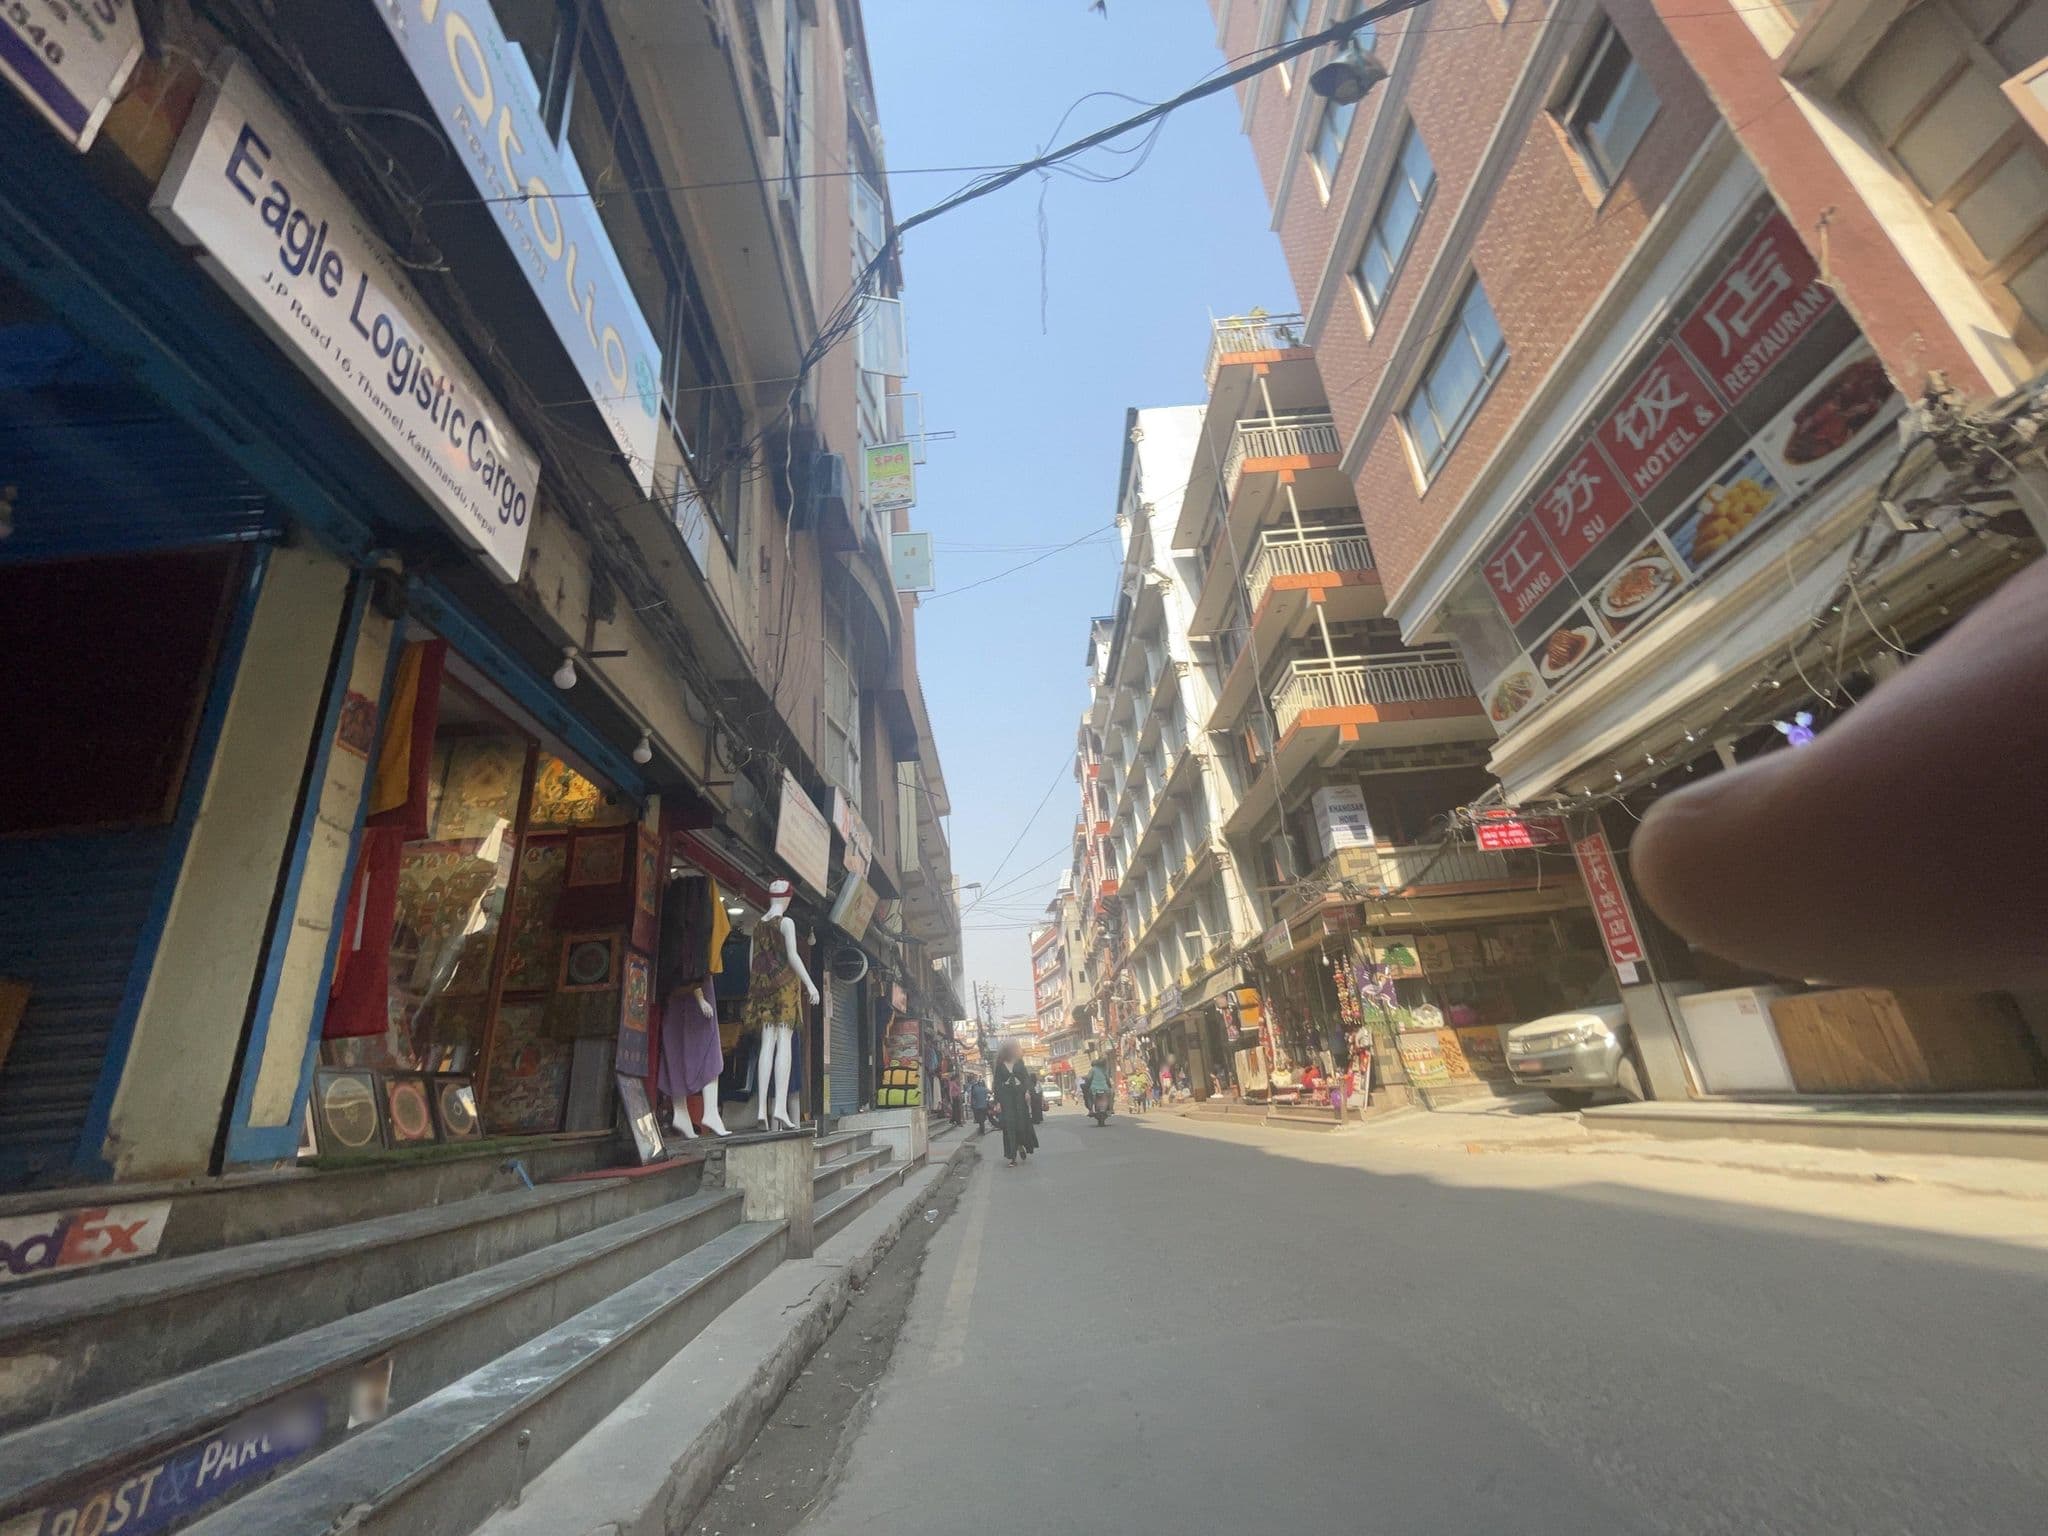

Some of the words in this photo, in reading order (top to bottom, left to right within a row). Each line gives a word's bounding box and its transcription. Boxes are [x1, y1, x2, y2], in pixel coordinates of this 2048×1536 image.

[225, 121, 343, 298] Eagle
[350, 271, 465, 449] Logistic
[468, 420, 526, 527] Cargo
[290, 298, 331, 350] Road
[357, 370, 405, 436] Thamel,
[406, 429, 469, 508] Kathmandu,
[469, 501, 497, 537] Nepal
[1517, 570, 1551, 613] JIANG
[1582, 513, 1606, 544] SU
[1632, 425, 1698, 489] HOTEL
[1694, 404, 1715, 427] &
